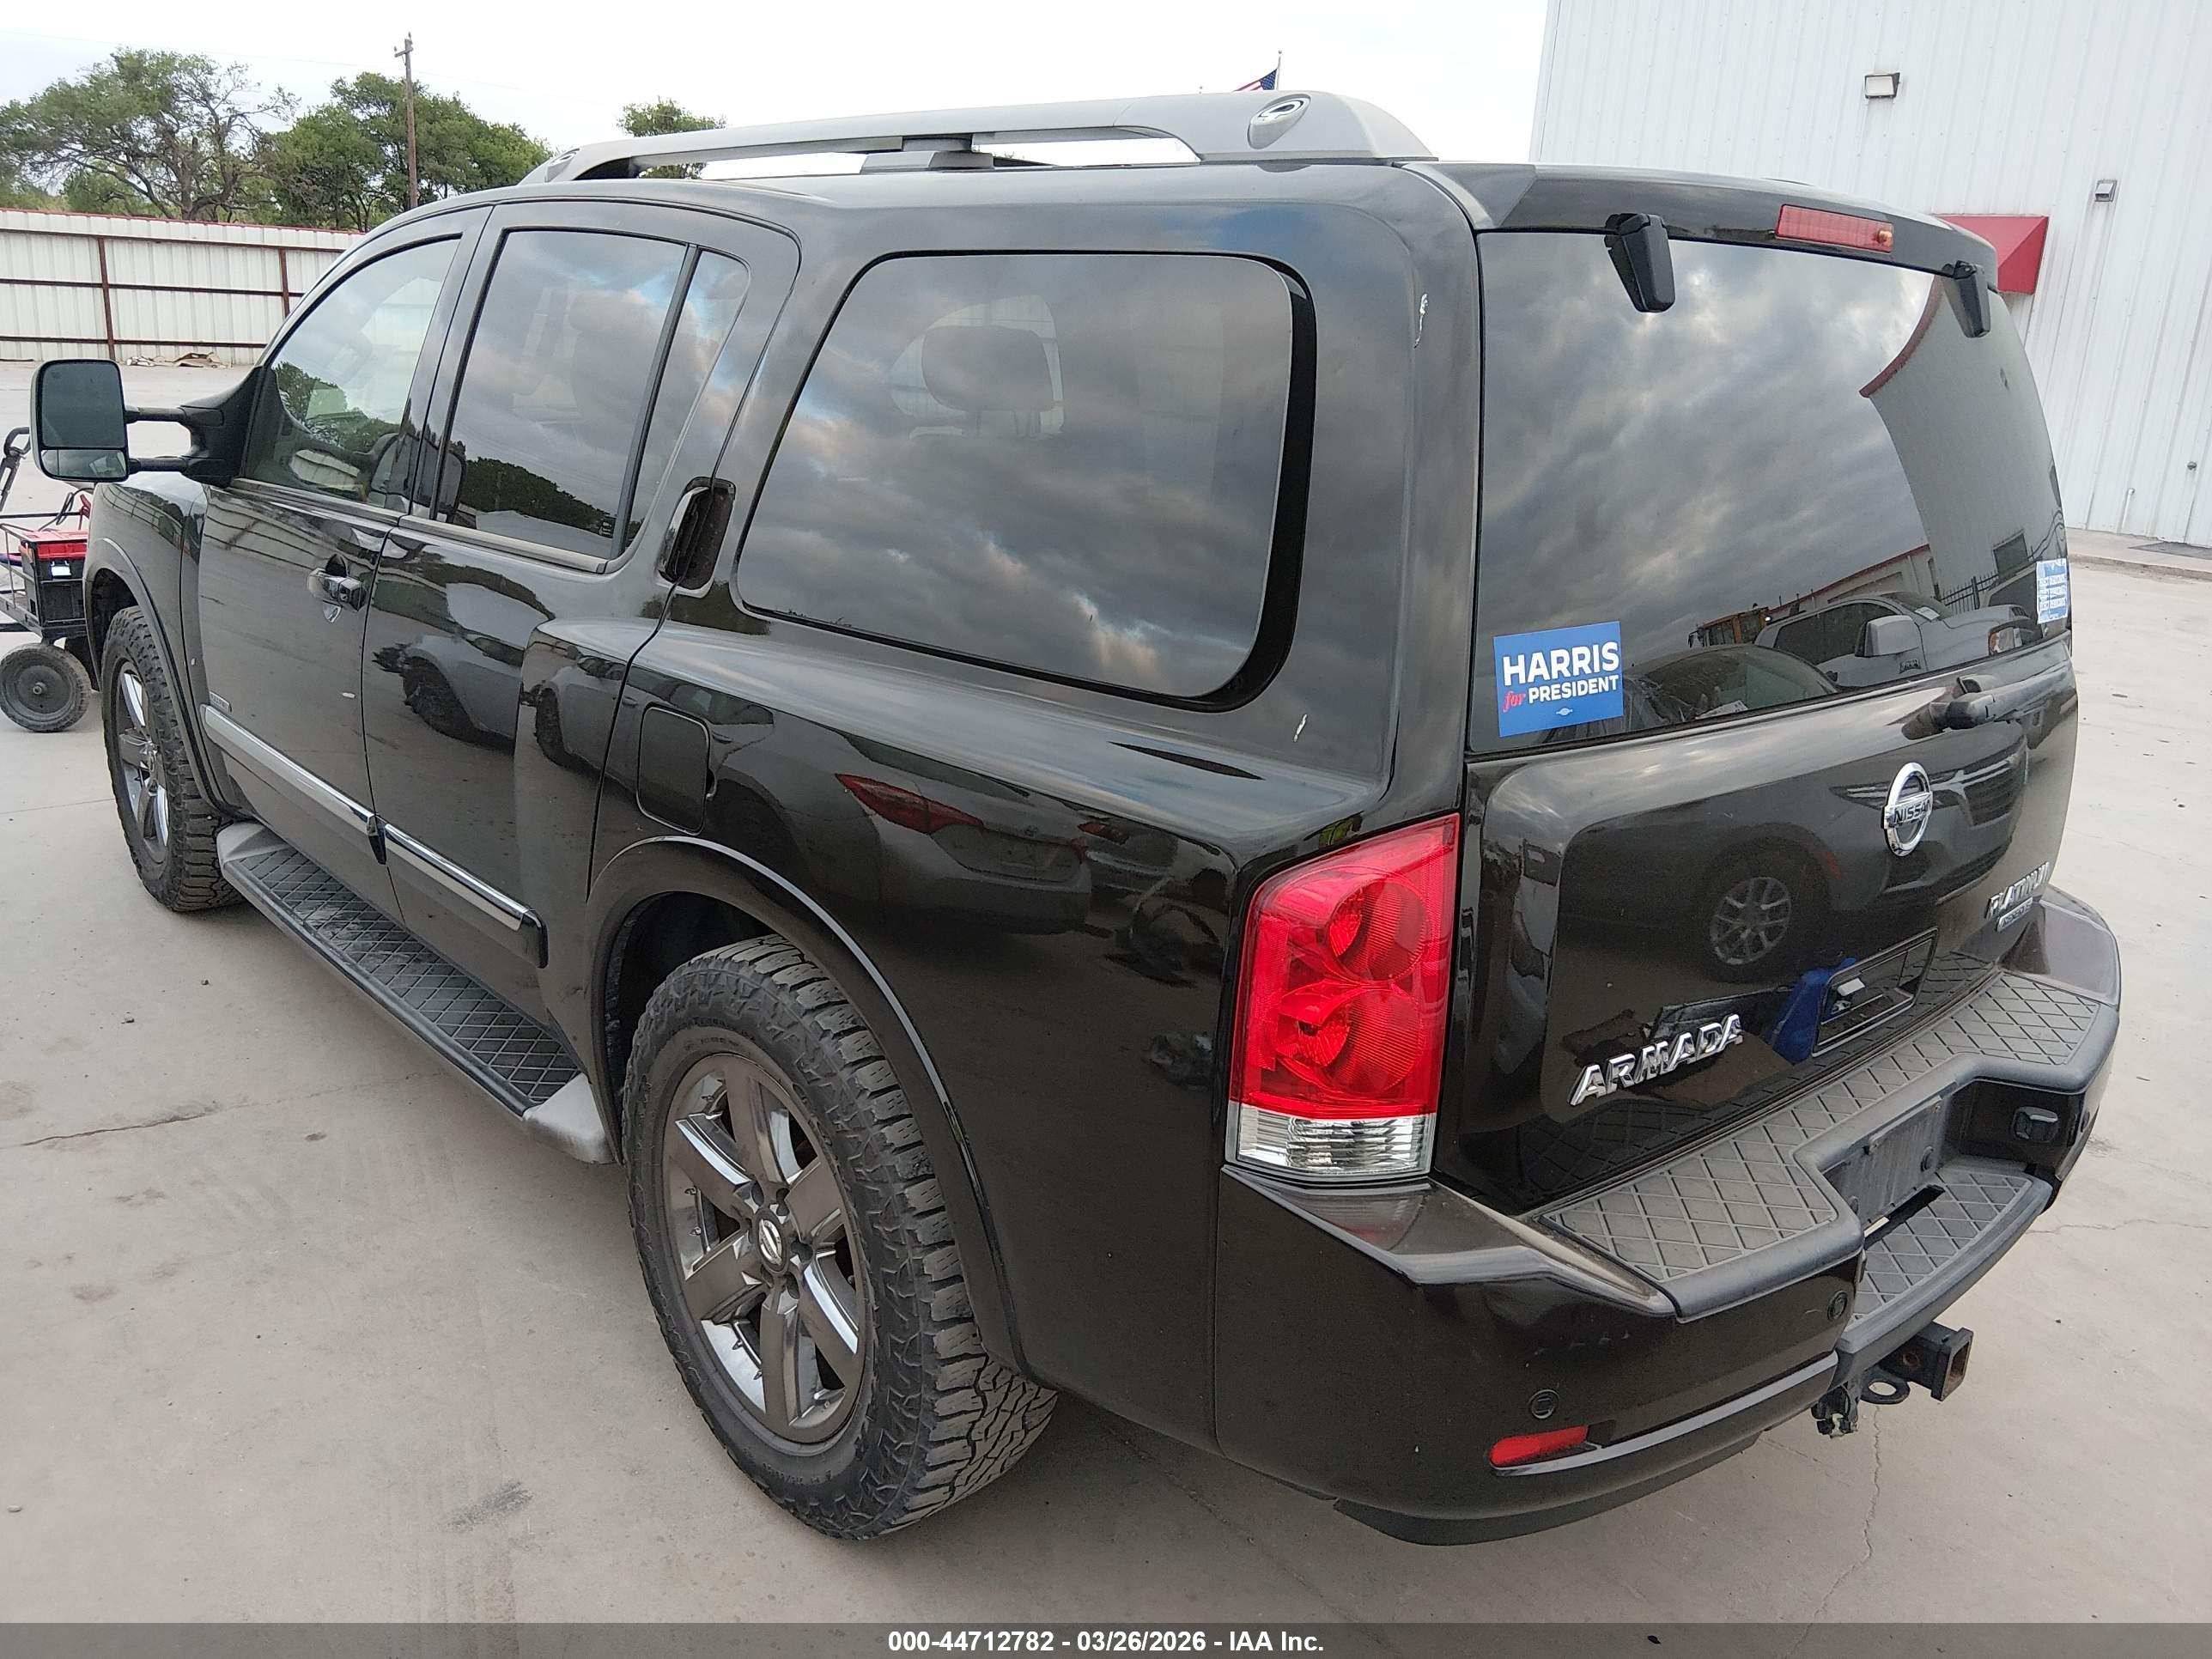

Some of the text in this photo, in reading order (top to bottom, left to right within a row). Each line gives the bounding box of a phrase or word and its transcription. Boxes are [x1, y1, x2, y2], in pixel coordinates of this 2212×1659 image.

[1503, 641, 1620, 686] HARRIS
[1503, 675, 1620, 713] for PRESIDENT
[1893, 799, 1931, 823] NISSAN
[1569, 1013, 1744, 1106] ARMADA
